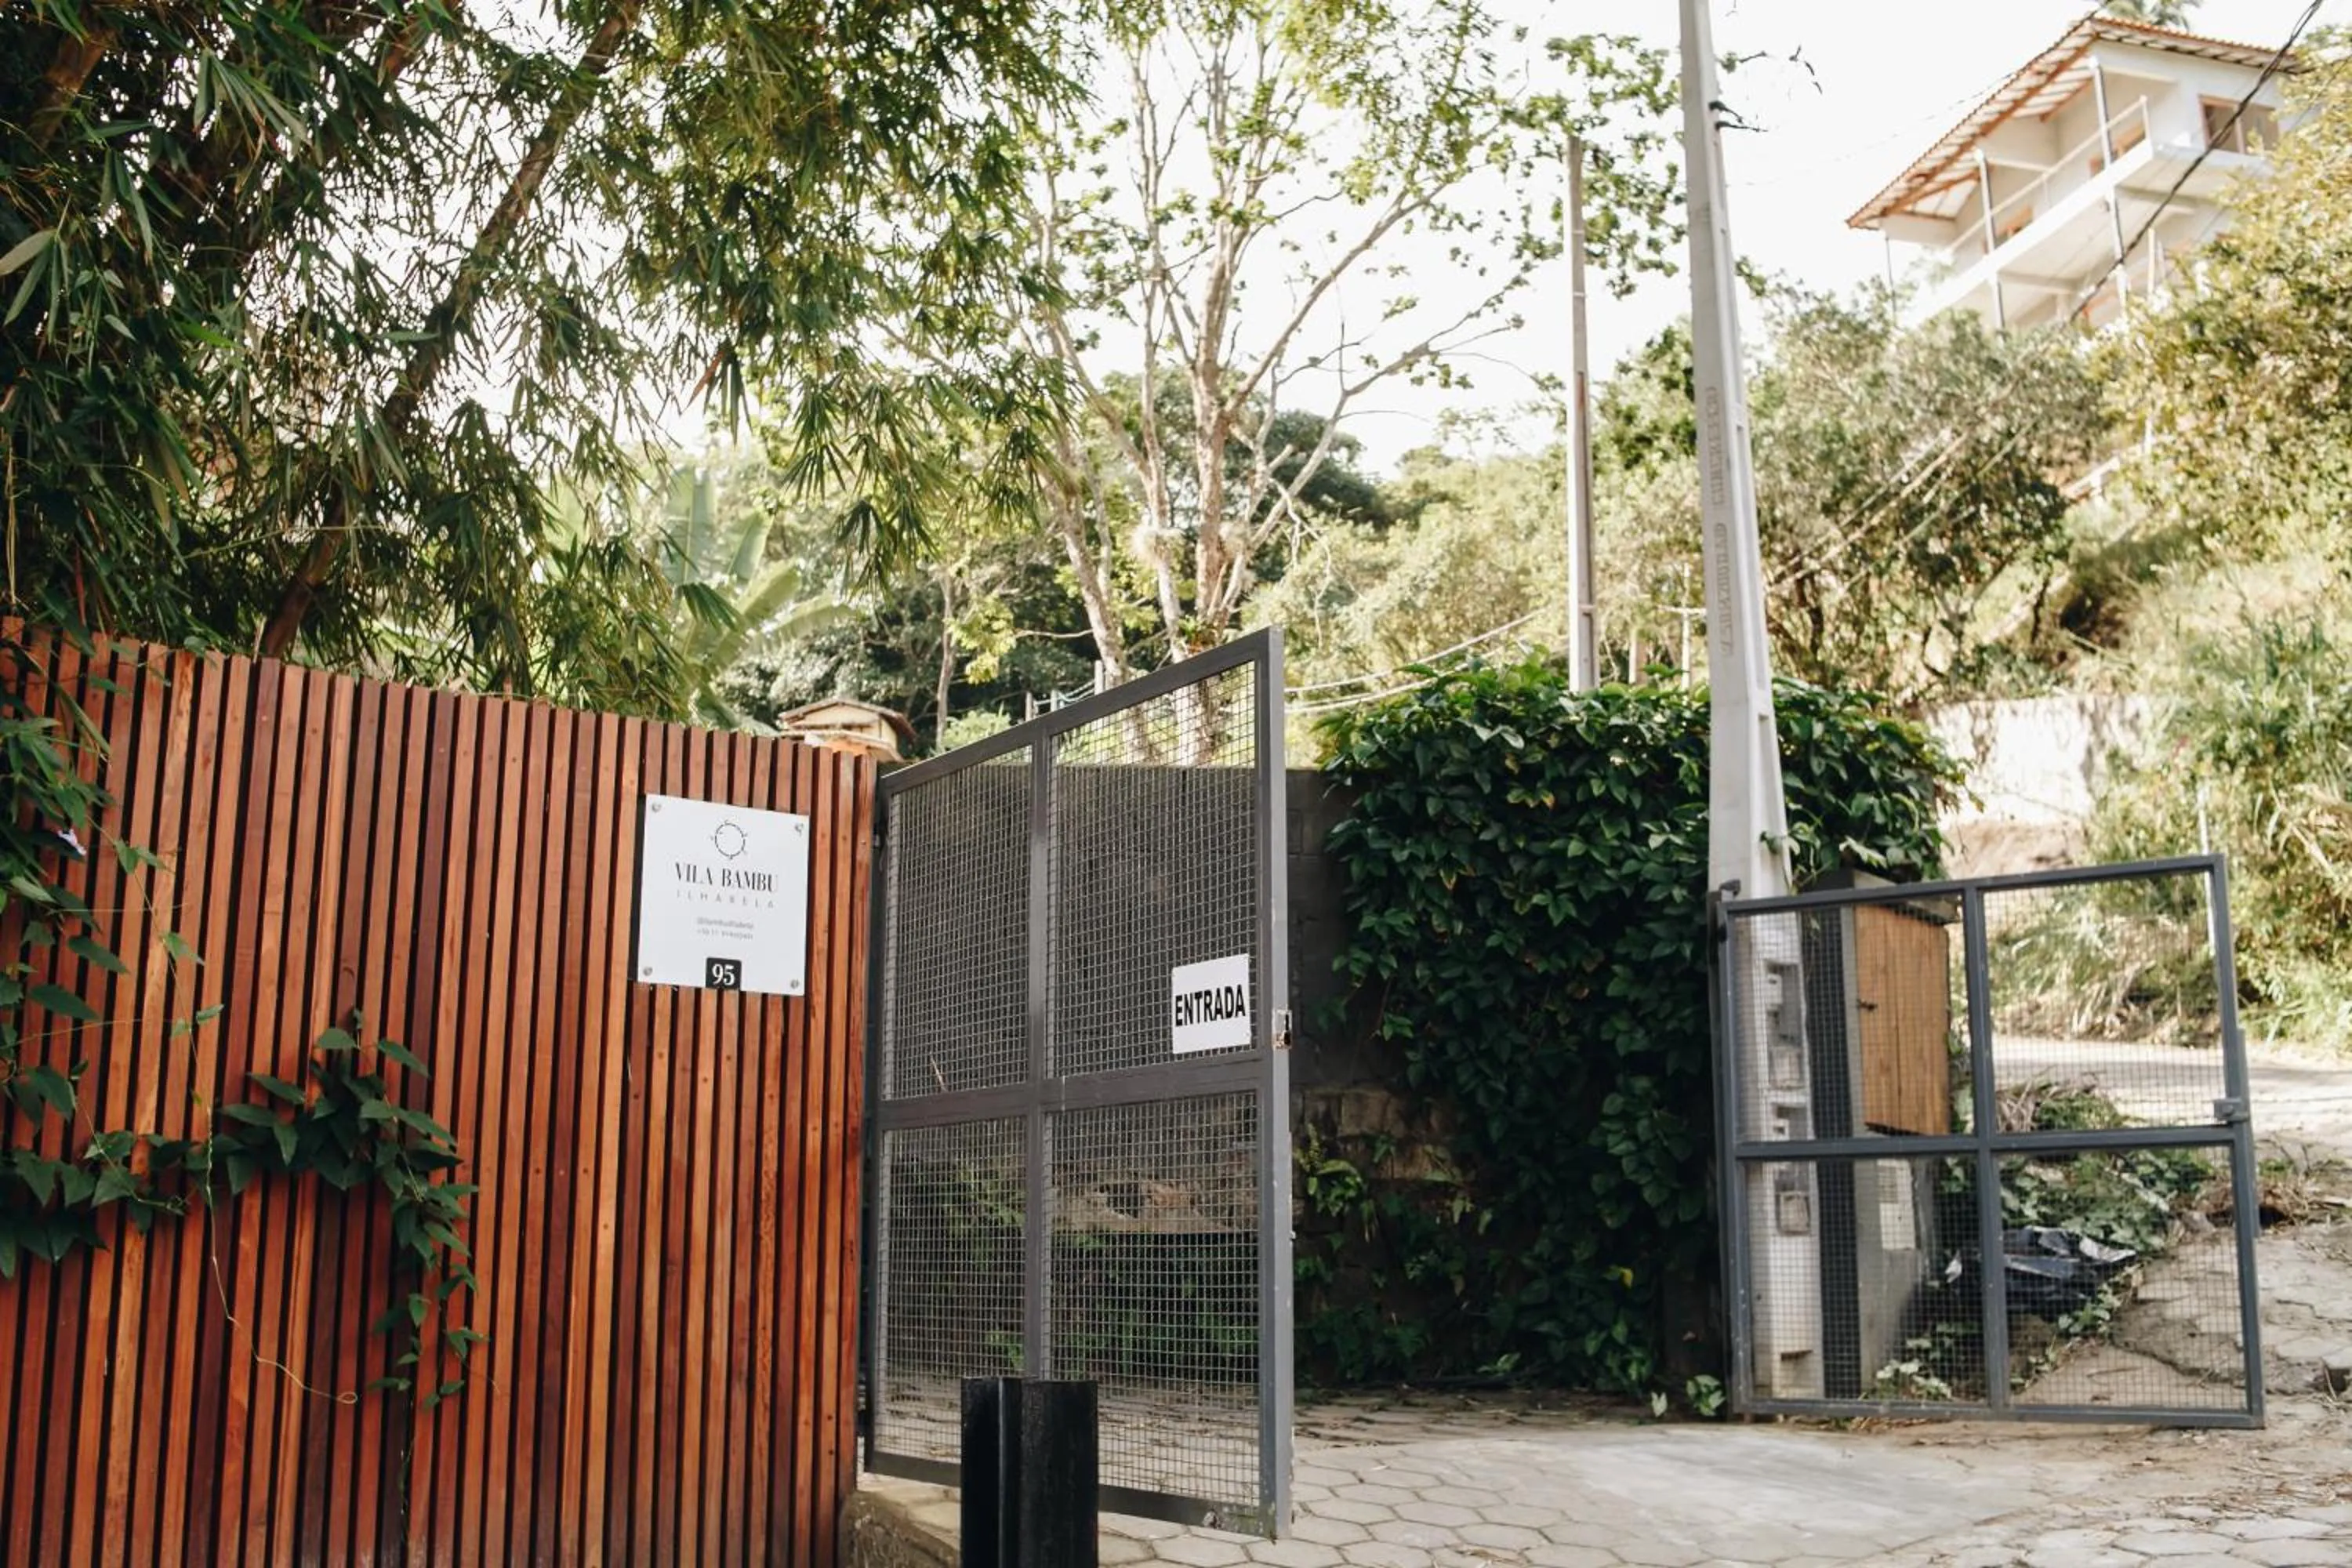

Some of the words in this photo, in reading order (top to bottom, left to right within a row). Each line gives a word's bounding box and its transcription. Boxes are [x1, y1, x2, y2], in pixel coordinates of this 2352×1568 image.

[675, 862, 713, 885] VILA
[721, 868, 779, 892] BAMBU
[712, 964, 735, 985] 95
[1175, 984, 1246, 1027] ENTRADA
